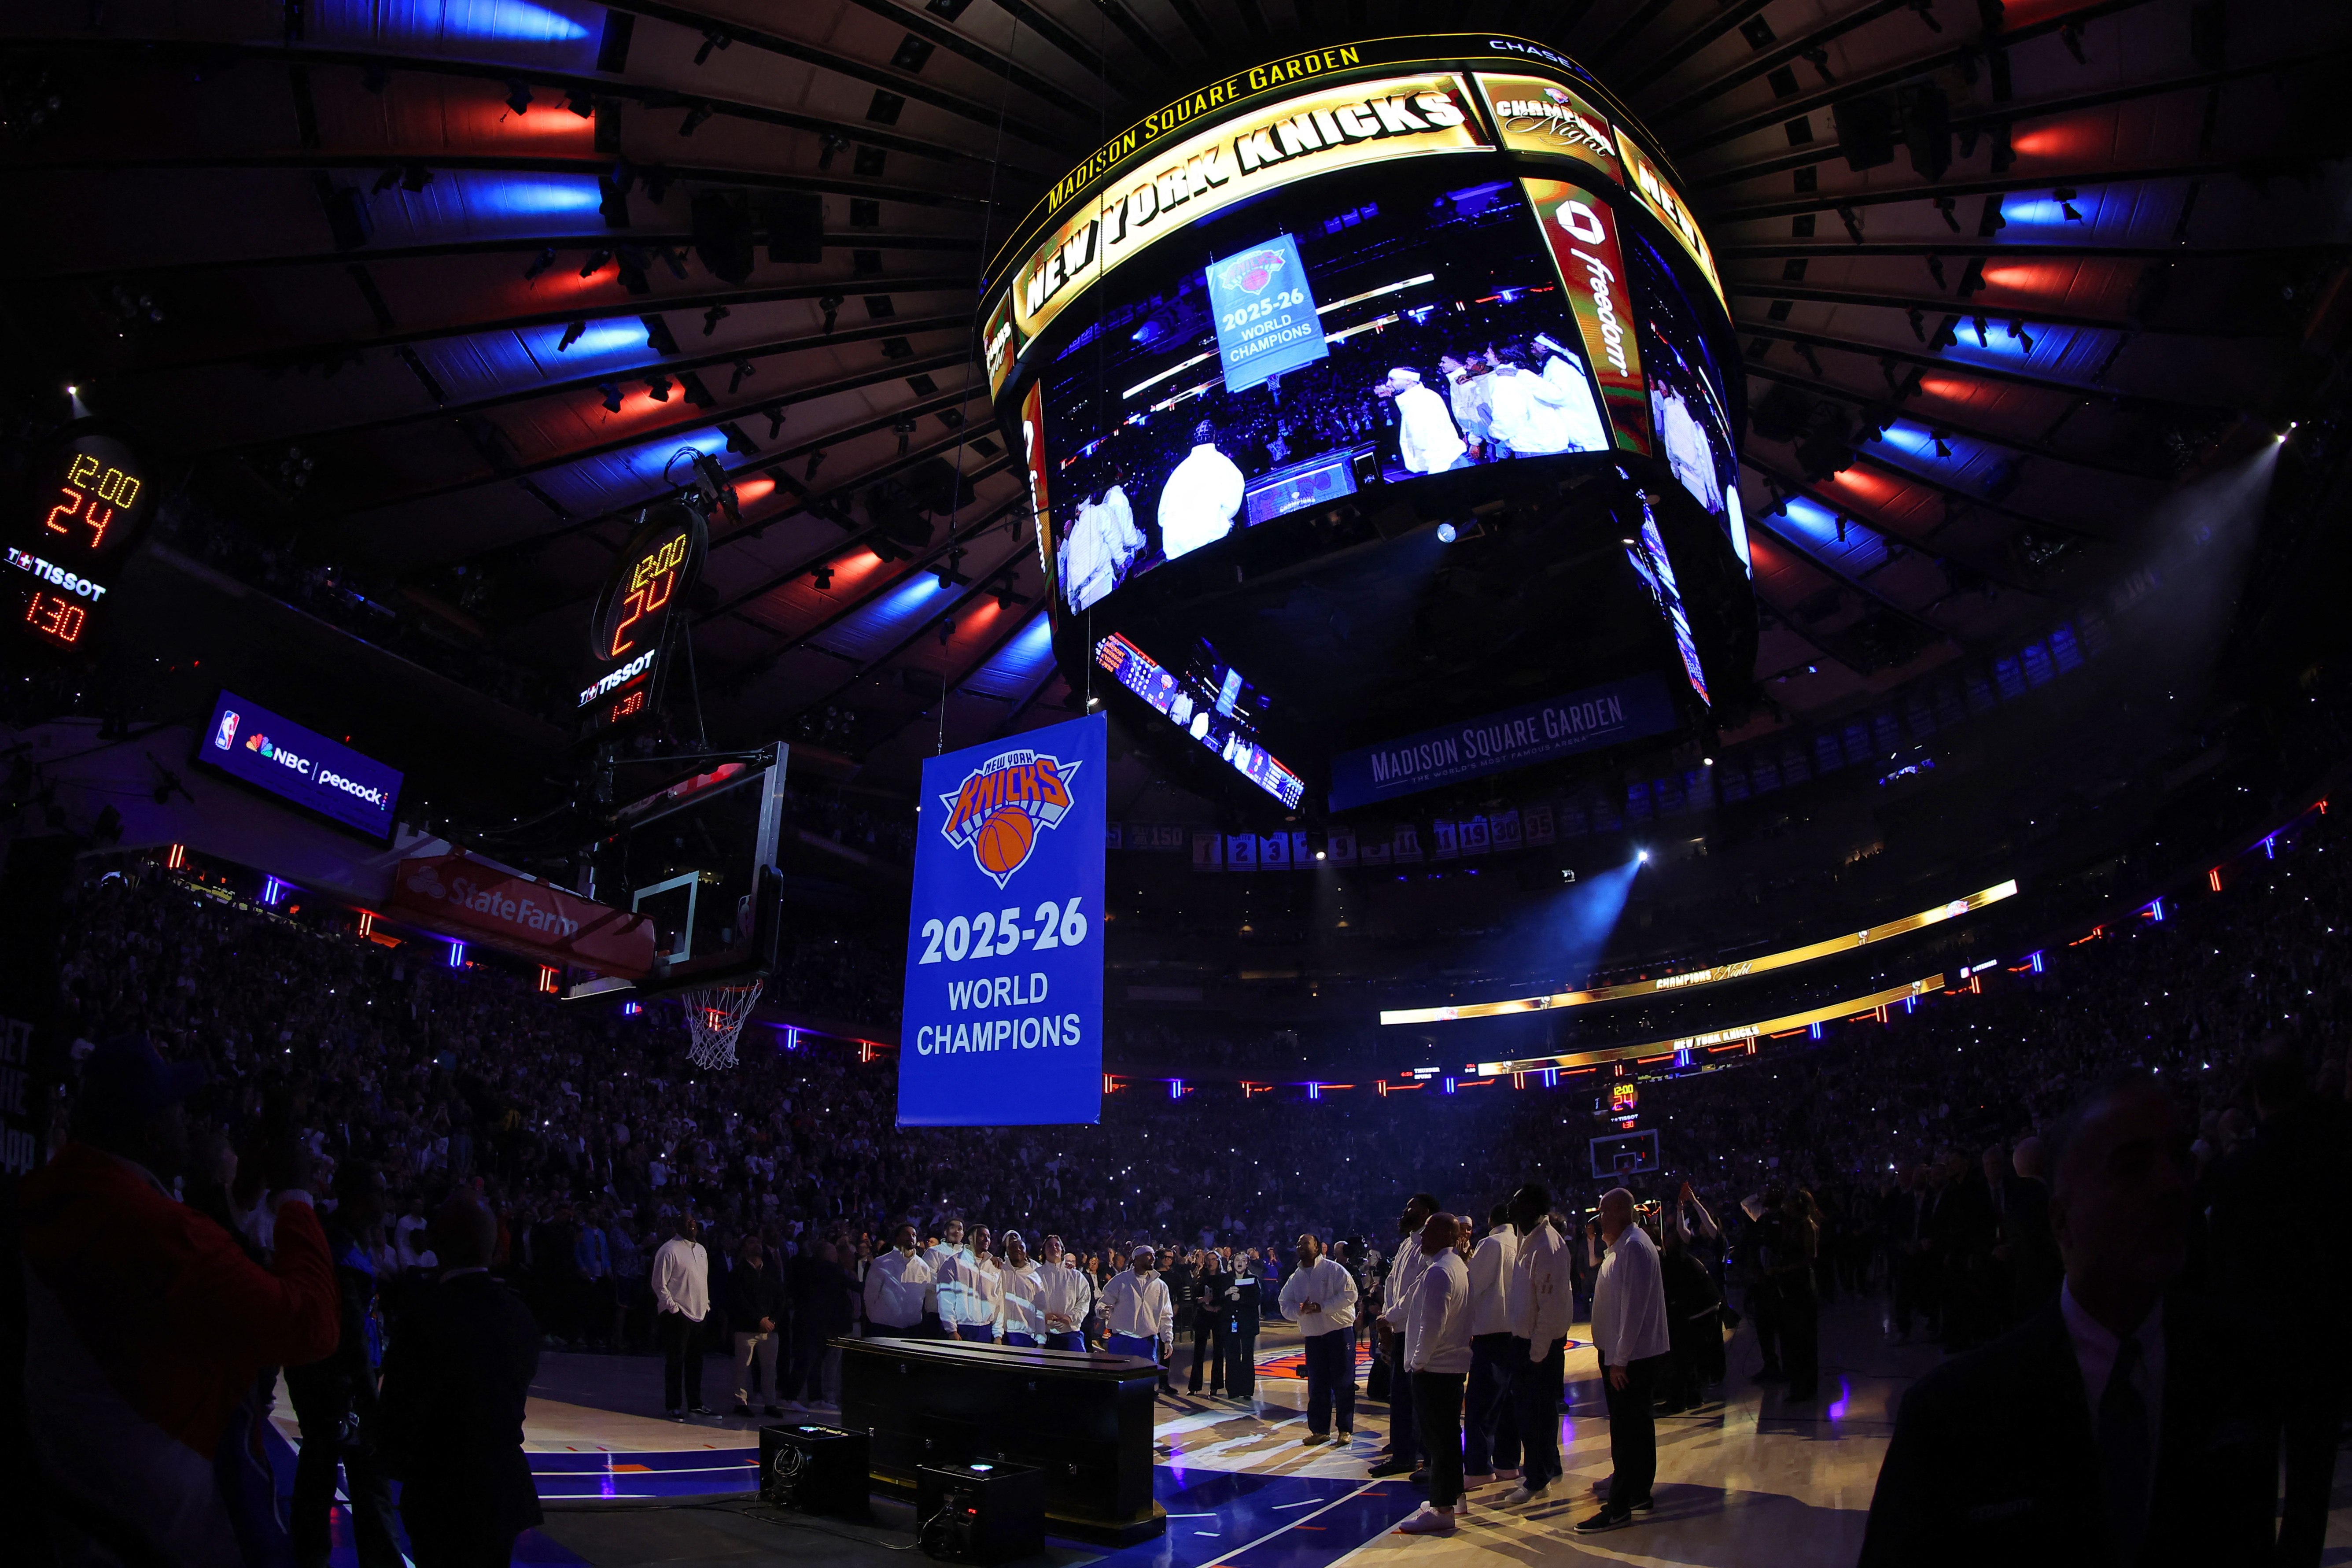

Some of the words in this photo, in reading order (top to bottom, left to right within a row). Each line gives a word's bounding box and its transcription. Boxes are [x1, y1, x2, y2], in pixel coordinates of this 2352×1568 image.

[1489, 41, 1572, 69] CHASE
[1048, 133, 1136, 214] MADISON
[1145, 78, 1240, 139] SQUARE
[1249, 47, 1360, 90] GARDEN
[1505, 111, 1606, 156] Night
[1026, 219, 1099, 320] NEW
[1102, 144, 1230, 244] YORK
[1233, 90, 1466, 176] KNICKS
[1638, 159, 1696, 247] NEW
[1222, 288, 1304, 332] 2025-26
[1241, 314, 1292, 341] WORLD
[1570, 248, 1627, 370] freedom
[1230, 323, 1312, 362] CHAMPIONS
[67, 454, 140, 509] 12:00
[47, 488, 111, 548] 24
[34, 557, 106, 601] TISSOT
[26, 592, 84, 642] 1:30
[1103, 646, 1123, 664] BRUNSON
[1105, 641, 1125, 658] ANUNOBY
[599, 649, 654, 694] TISSOT
[1156, 703, 1167, 714] 12:00
[1371, 738, 1459, 782] MADISON
[1462, 716, 1539, 760] SQUARE
[1543, 695, 1623, 739] GARDEN
[1412, 774, 1430, 783] THE
[1434, 763, 1477, 778] WORLD'S
[1480, 756, 1507, 767] MOST
[1511, 744, 1551, 759] FAMOUS
[1554, 736, 1587, 749] ARENA
[273, 748, 310, 774] NBC
[318, 770, 383, 805] peacock
[984, 756, 1006, 775] NEW
[1007, 753, 1033, 766] YORK
[947, 760, 1069, 833] KNICKS
[1236, 842, 1248, 861] 2
[1268, 841, 1280, 860] 3
[1463, 825, 1485, 845] 19
[918, 897, 1088, 965] 2025-26
[948, 972, 1048, 1011] WORLD
[1656, 970, 1712, 990] CHAMPIONS
[1713, 963, 1753, 981] Night
[917, 1014, 1081, 1056] CHAMPIONS
[1674, 1038, 1695, 1050] NEW
[1695, 1033, 1722, 1046] YORK
[1722, 1026, 1760, 1041] KNICKS
[1613, 1084, 1633, 1096] 12:00
[1613, 1094, 1635, 1111] 24
